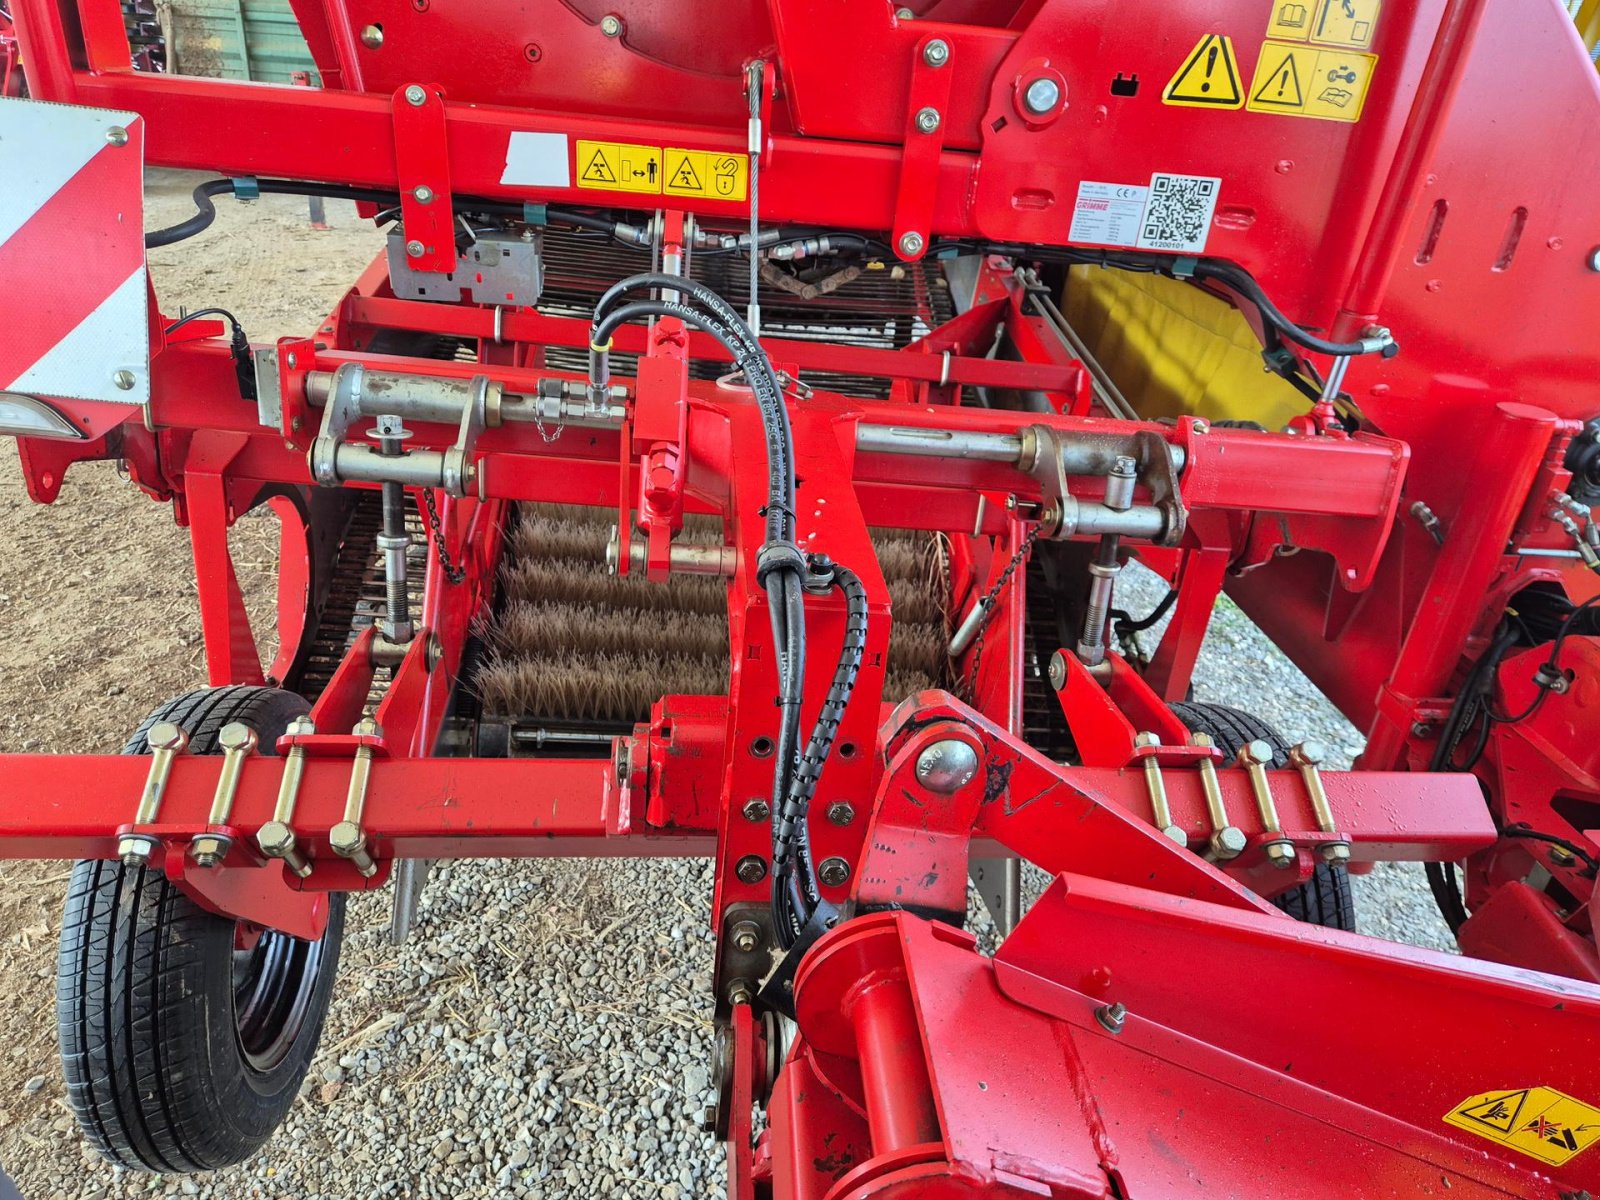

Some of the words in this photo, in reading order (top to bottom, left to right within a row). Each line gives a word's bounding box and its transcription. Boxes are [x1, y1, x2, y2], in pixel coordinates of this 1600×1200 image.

[1116, 188, 1129, 198] CE
[1077, 201, 1108, 211] GRIMME
[1149, 241, 1184, 249] 41200101
[663, 301, 727, 335] HANSA-FLEX
[693, 287, 745, 339] HANSA-FLEX
[726, 335, 740, 347] KP
[747, 365, 763, 386] PRO
[757, 387, 771, 401] EN
[763, 403, 775, 418] 857
[767, 422, 778, 440] 2SC
